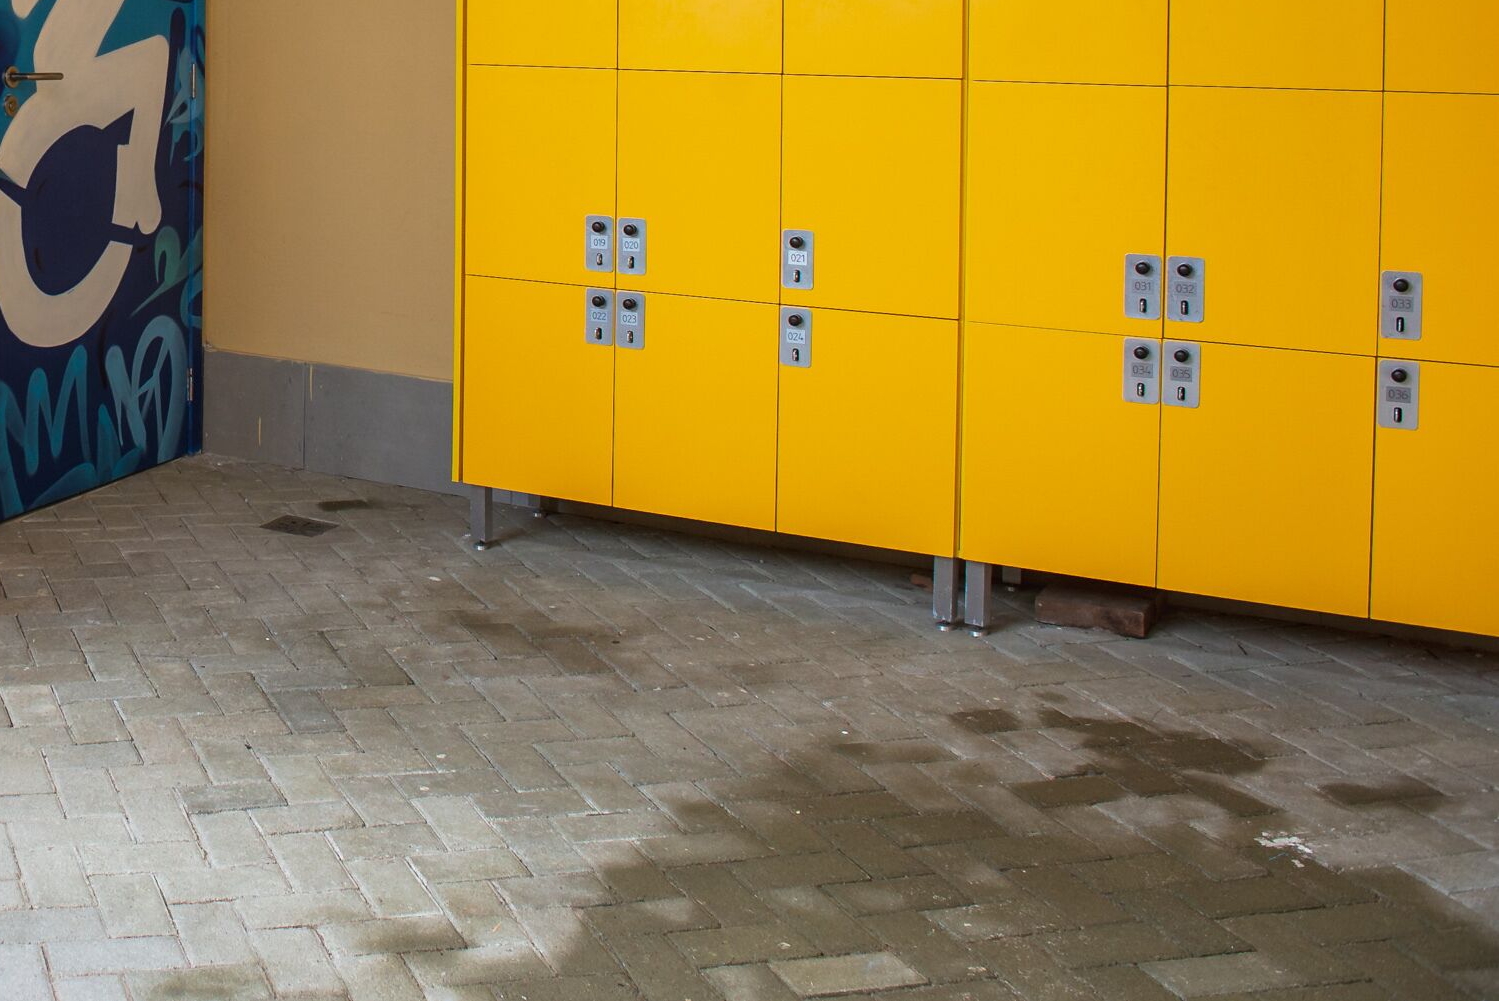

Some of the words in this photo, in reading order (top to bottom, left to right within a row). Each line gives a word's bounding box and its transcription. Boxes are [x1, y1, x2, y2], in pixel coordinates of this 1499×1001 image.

[593, 237, 606, 247] 019
[624, 240, 639, 250] 020
[790, 253, 805, 263] 021
[1134, 281, 1151, 292] 031
[1175, 283, 1194, 294] 032
[1391, 298, 1412, 310] 033
[592, 311, 607, 321] 022
[622, 314, 637, 324] 023
[787, 331, 804, 342] 024
[1132, 364, 1151, 375] 034
[1172, 368, 1191, 379] 035
